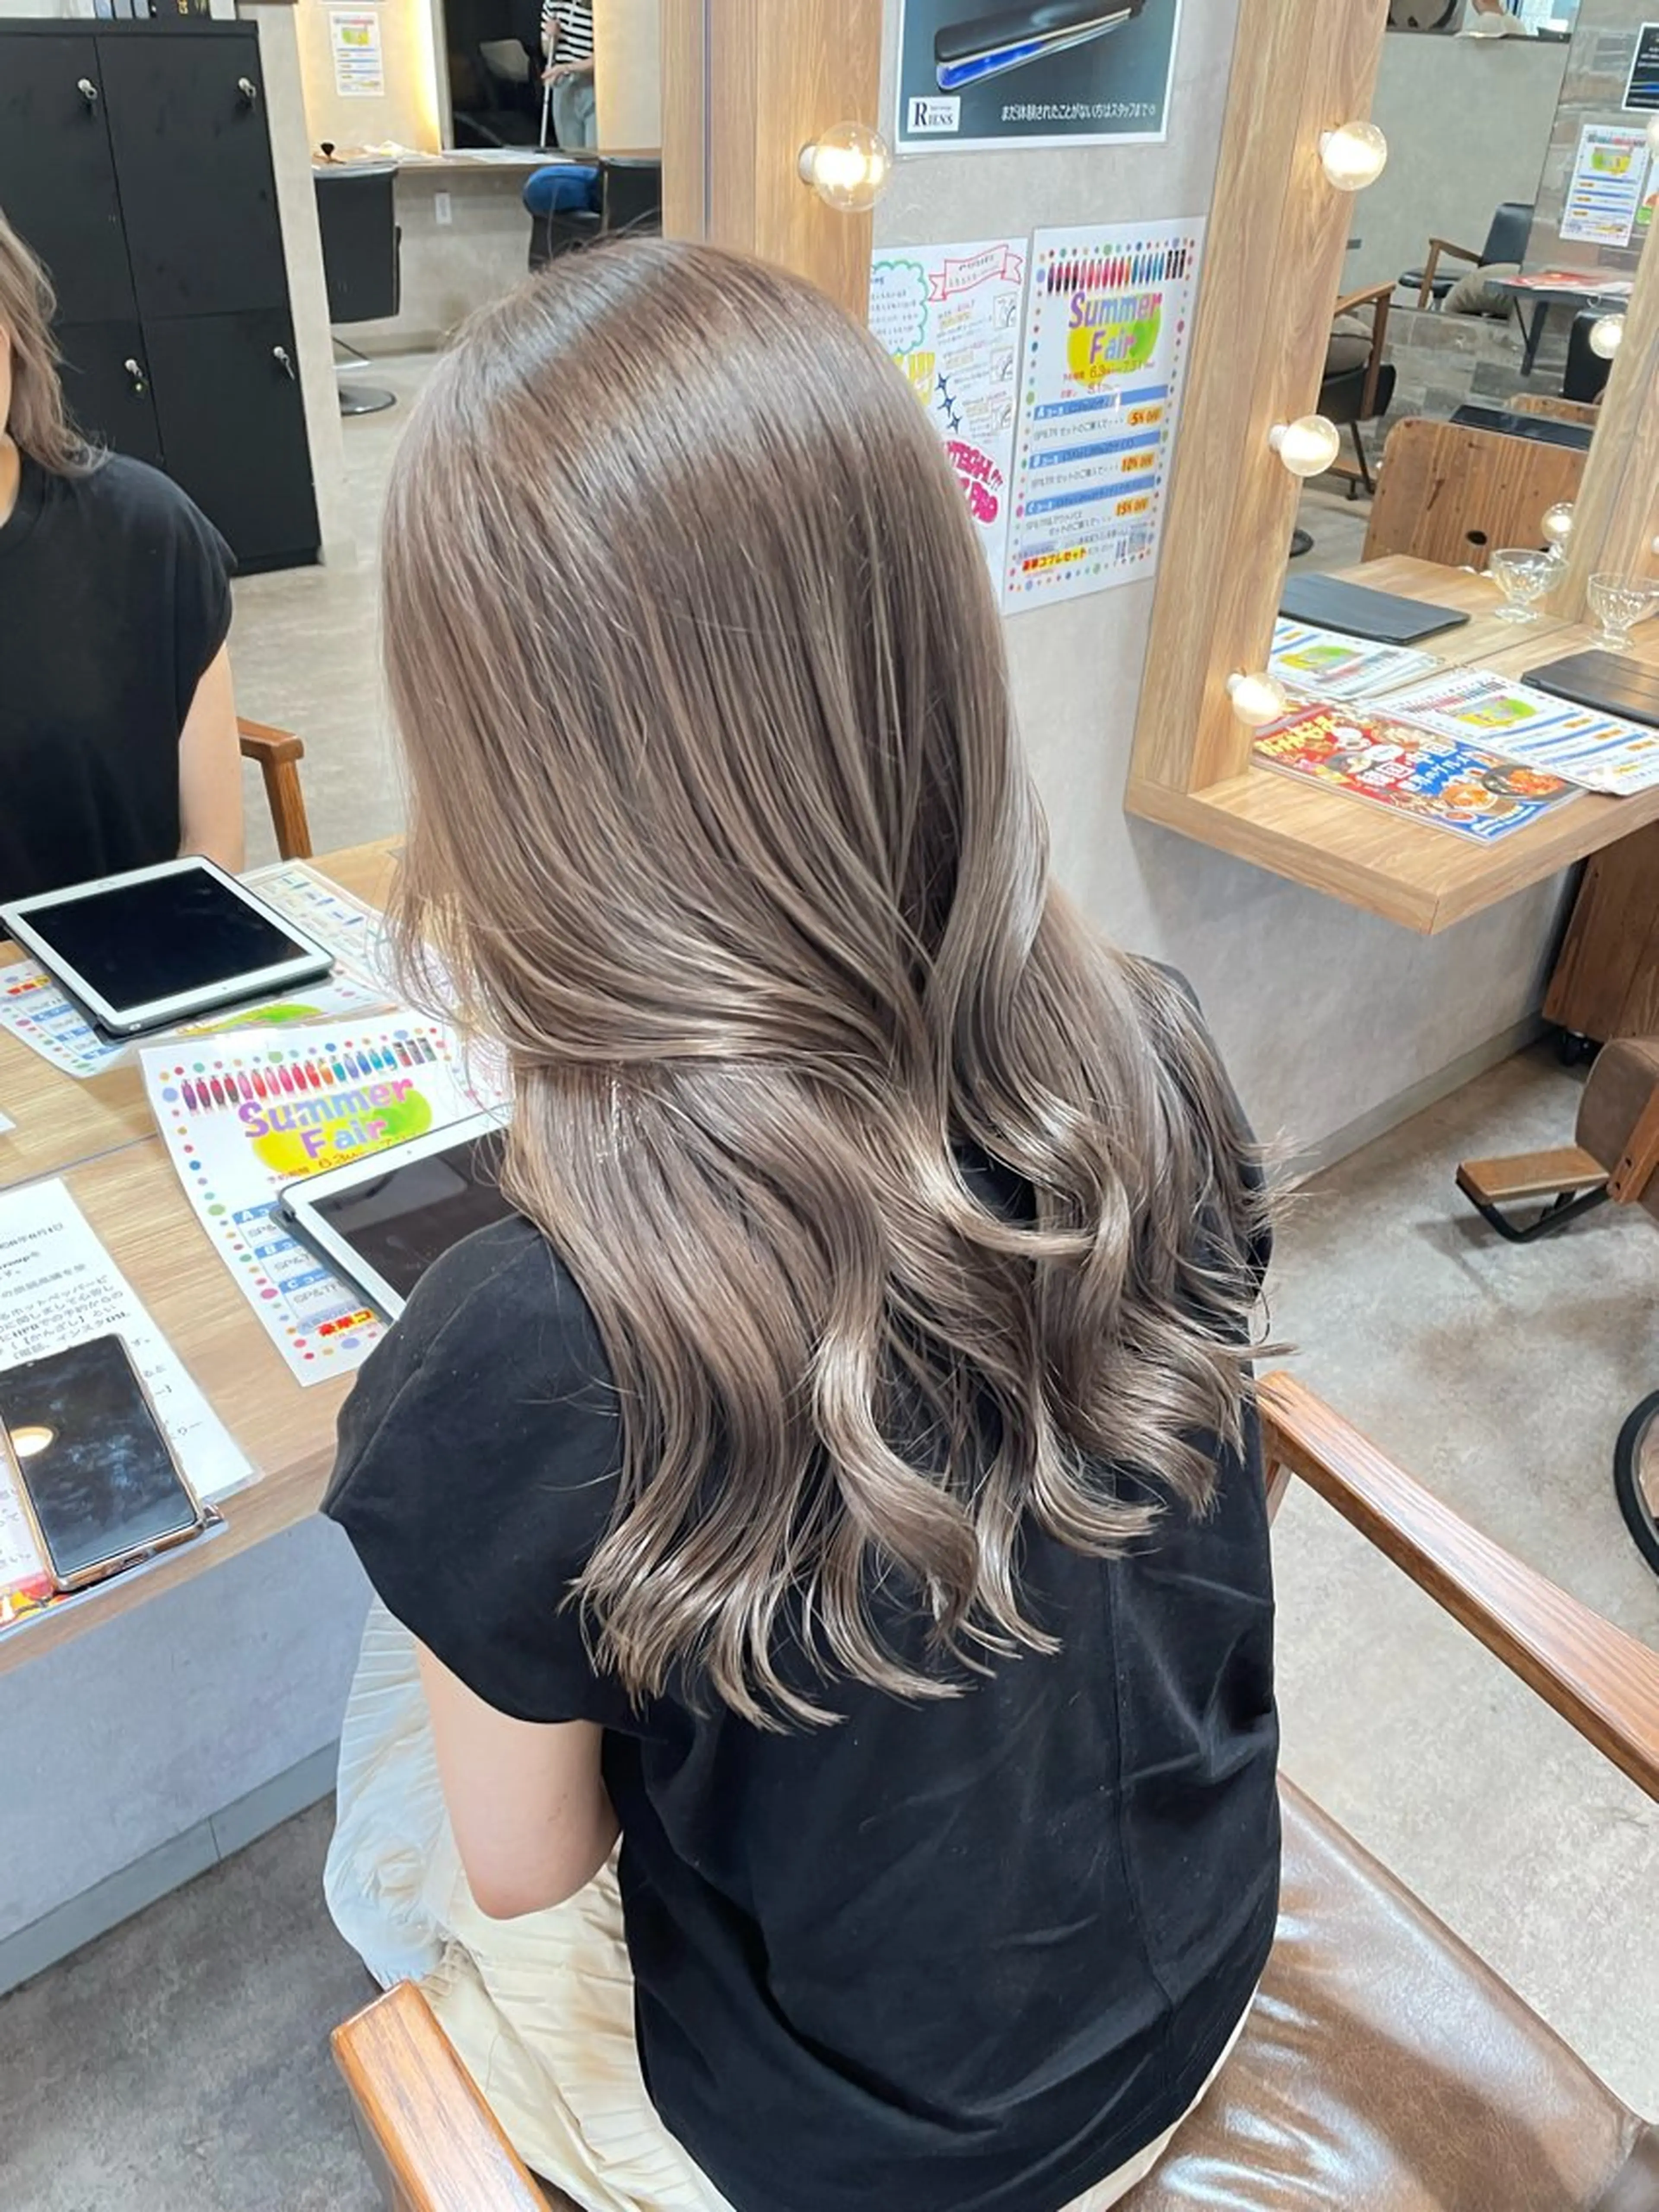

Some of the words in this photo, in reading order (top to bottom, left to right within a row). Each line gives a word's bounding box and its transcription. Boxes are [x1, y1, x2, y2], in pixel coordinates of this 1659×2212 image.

[1068, 291, 1163, 328] Summer
[1090, 327, 1136, 364] Fair
[238, 1078, 413, 1138] Summer
[300, 1119, 386, 1158] Fair
